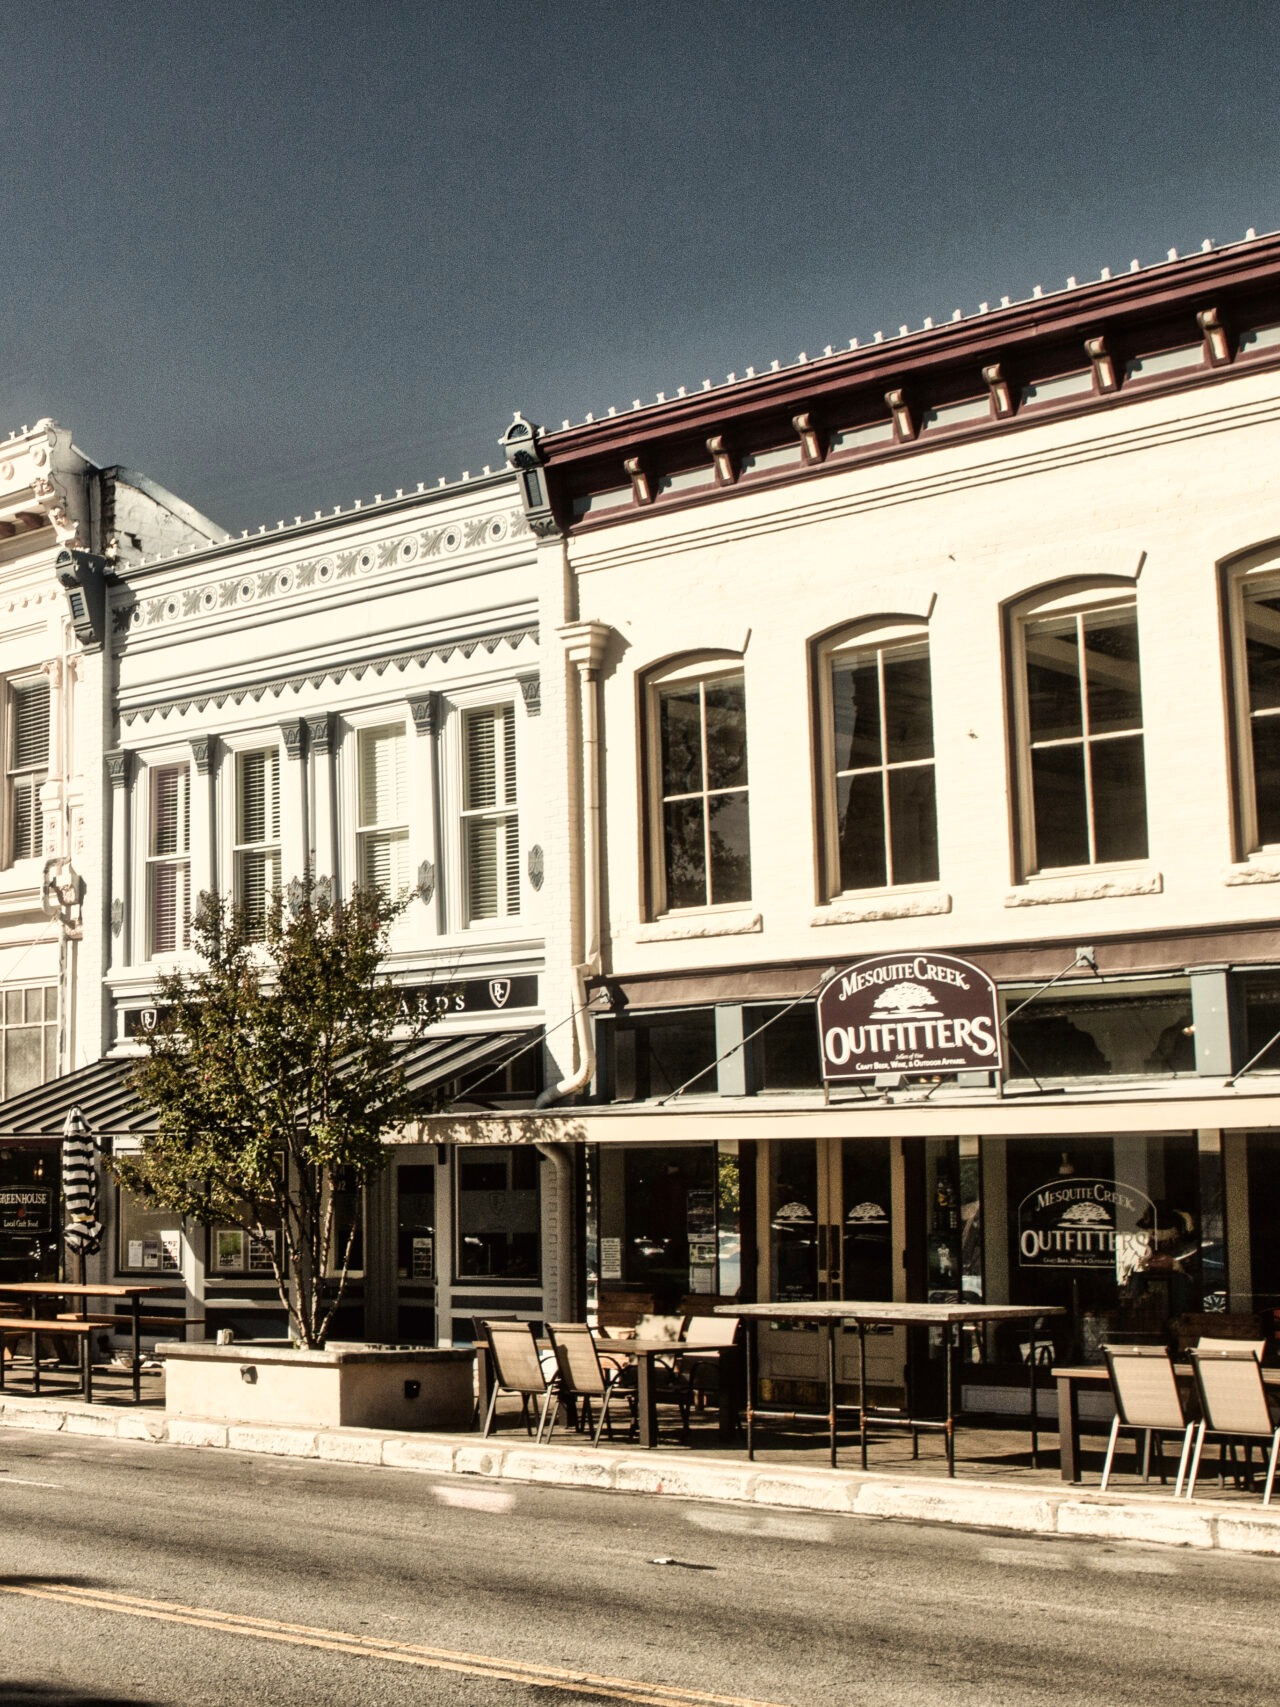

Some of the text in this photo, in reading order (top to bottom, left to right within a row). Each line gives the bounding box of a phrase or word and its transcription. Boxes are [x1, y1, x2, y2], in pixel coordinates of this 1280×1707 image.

[839, 957, 970, 1001] MESQUITE CREEK
[825, 1016, 996, 1065] OUTFITTERS
[856, 1063, 874, 1071] CRAFT
[1036, 1184, 1135, 1212] MESQUITE CREEK
[1021, 1230, 1152, 1259] OUTFITTERS
